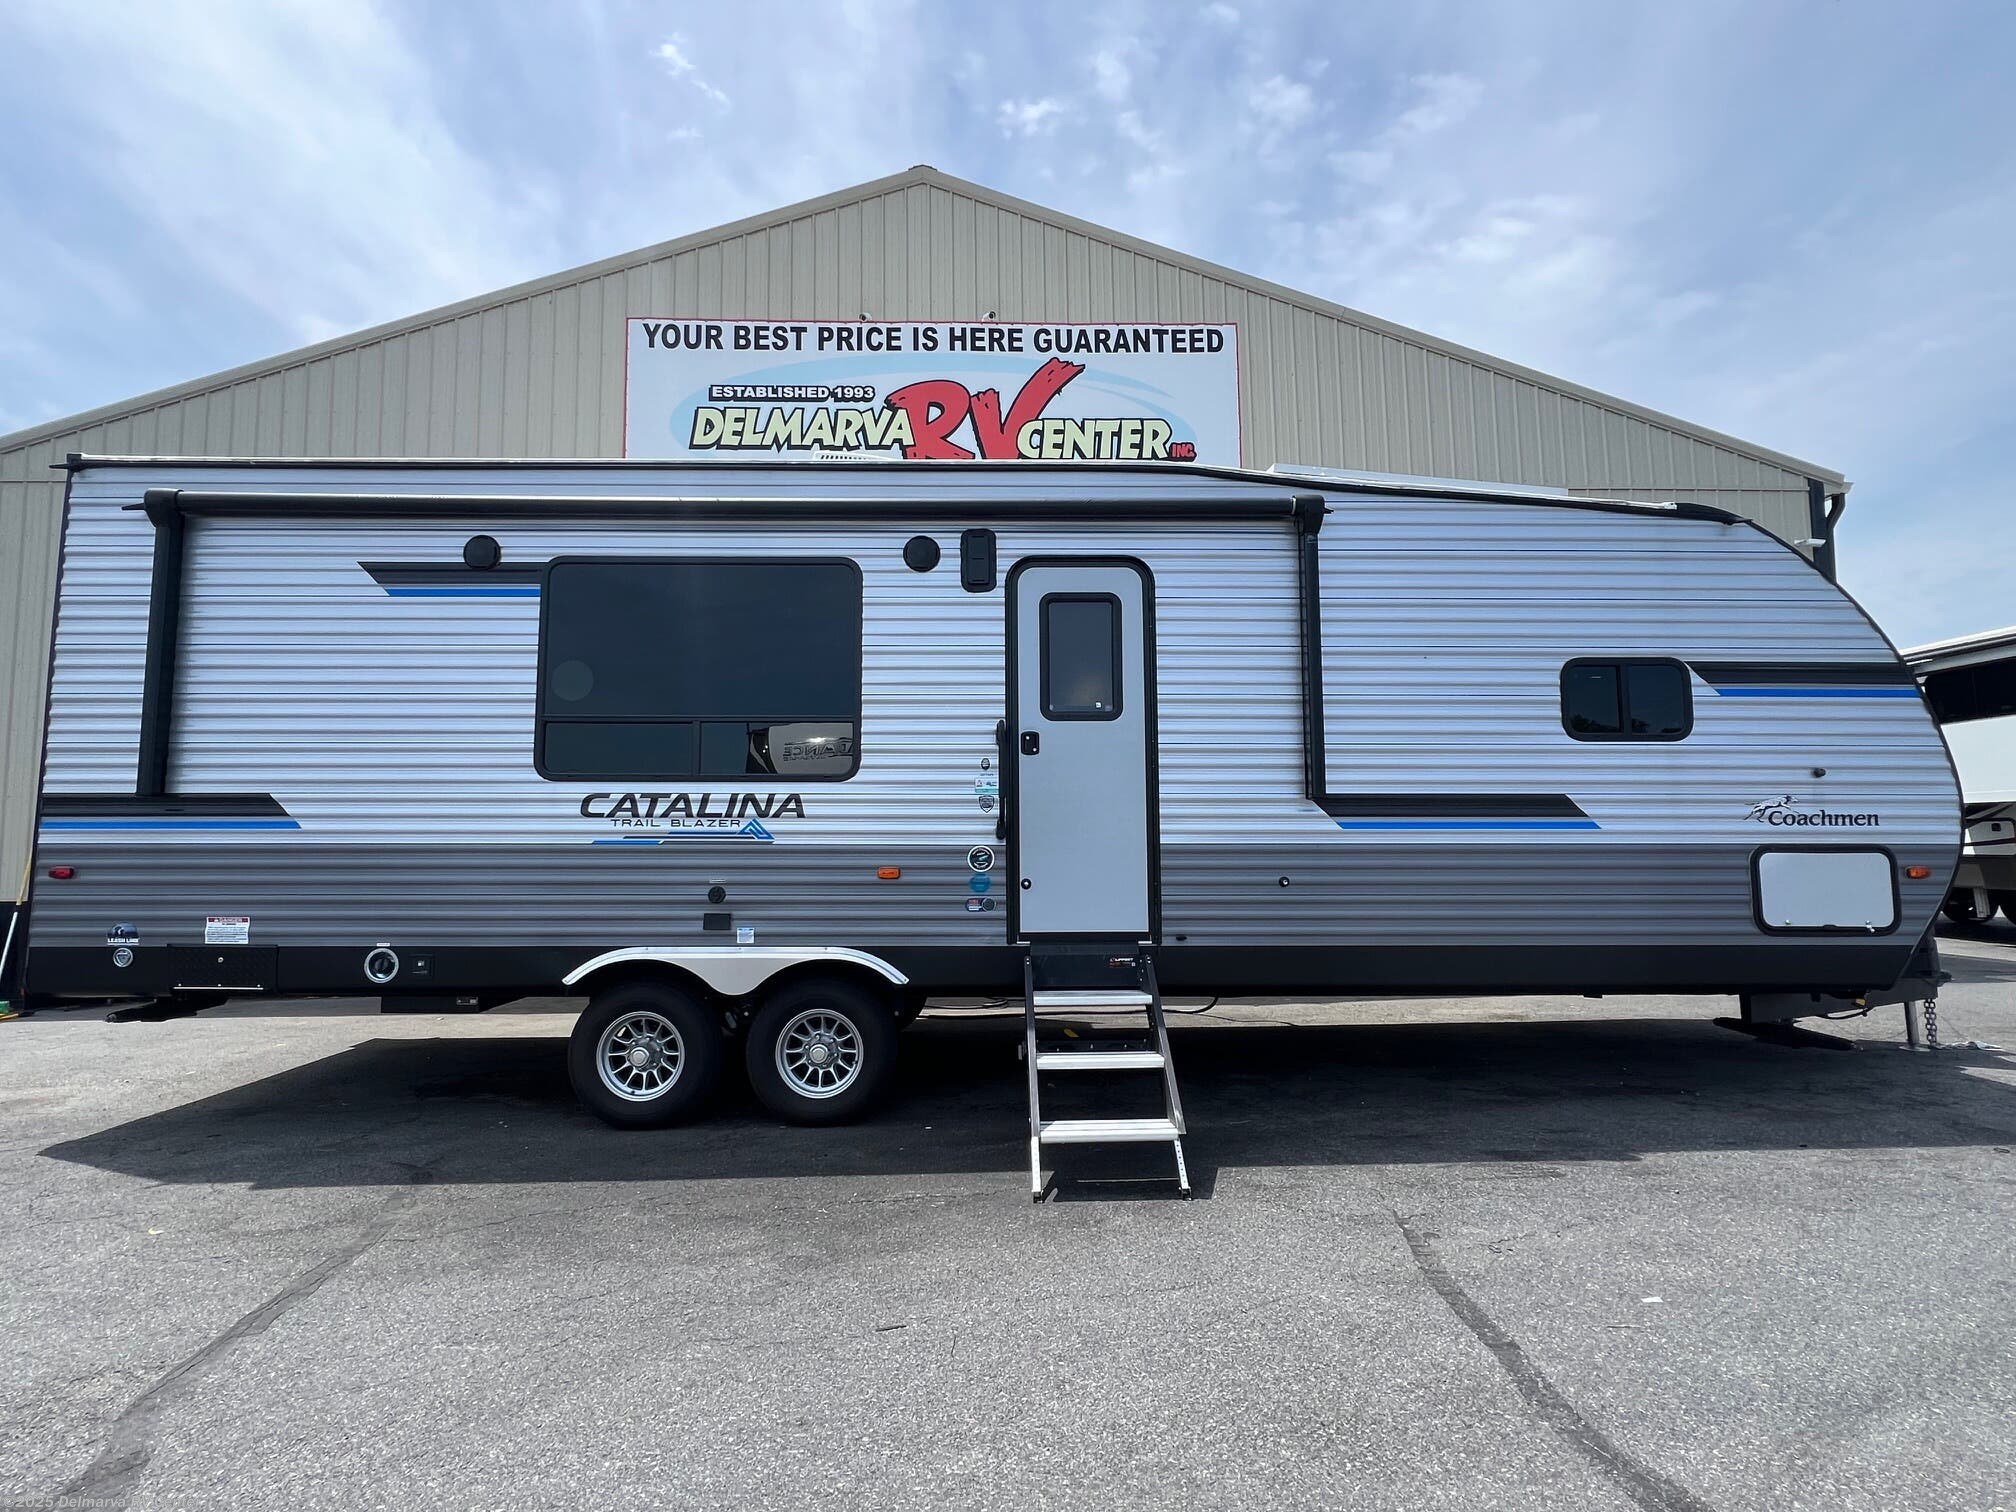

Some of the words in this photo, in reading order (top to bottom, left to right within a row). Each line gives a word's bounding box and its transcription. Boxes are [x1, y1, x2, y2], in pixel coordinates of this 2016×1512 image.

[643, 323, 724, 350] YOUR
[733, 325, 807, 351] BEST
[818, 326, 902, 351] PRICE
[912, 327, 939, 351] IS
[949, 327, 1024, 352] HERE
[1033, 328, 1224, 353] GUARANTEED
[711, 385, 830, 399] ESTABLISHED
[834, 386, 876, 399] 1993
[690, 406, 917, 452] DELMARVA
[884, 357, 1085, 459] RV
[1016, 418, 1172, 459] CENTER
[580, 793, 807, 819] CATALINA
[610, 819, 661, 828] TRAIL
[671, 819, 741, 828] BLAZER
[1768, 810, 1880, 827] Coachmen
